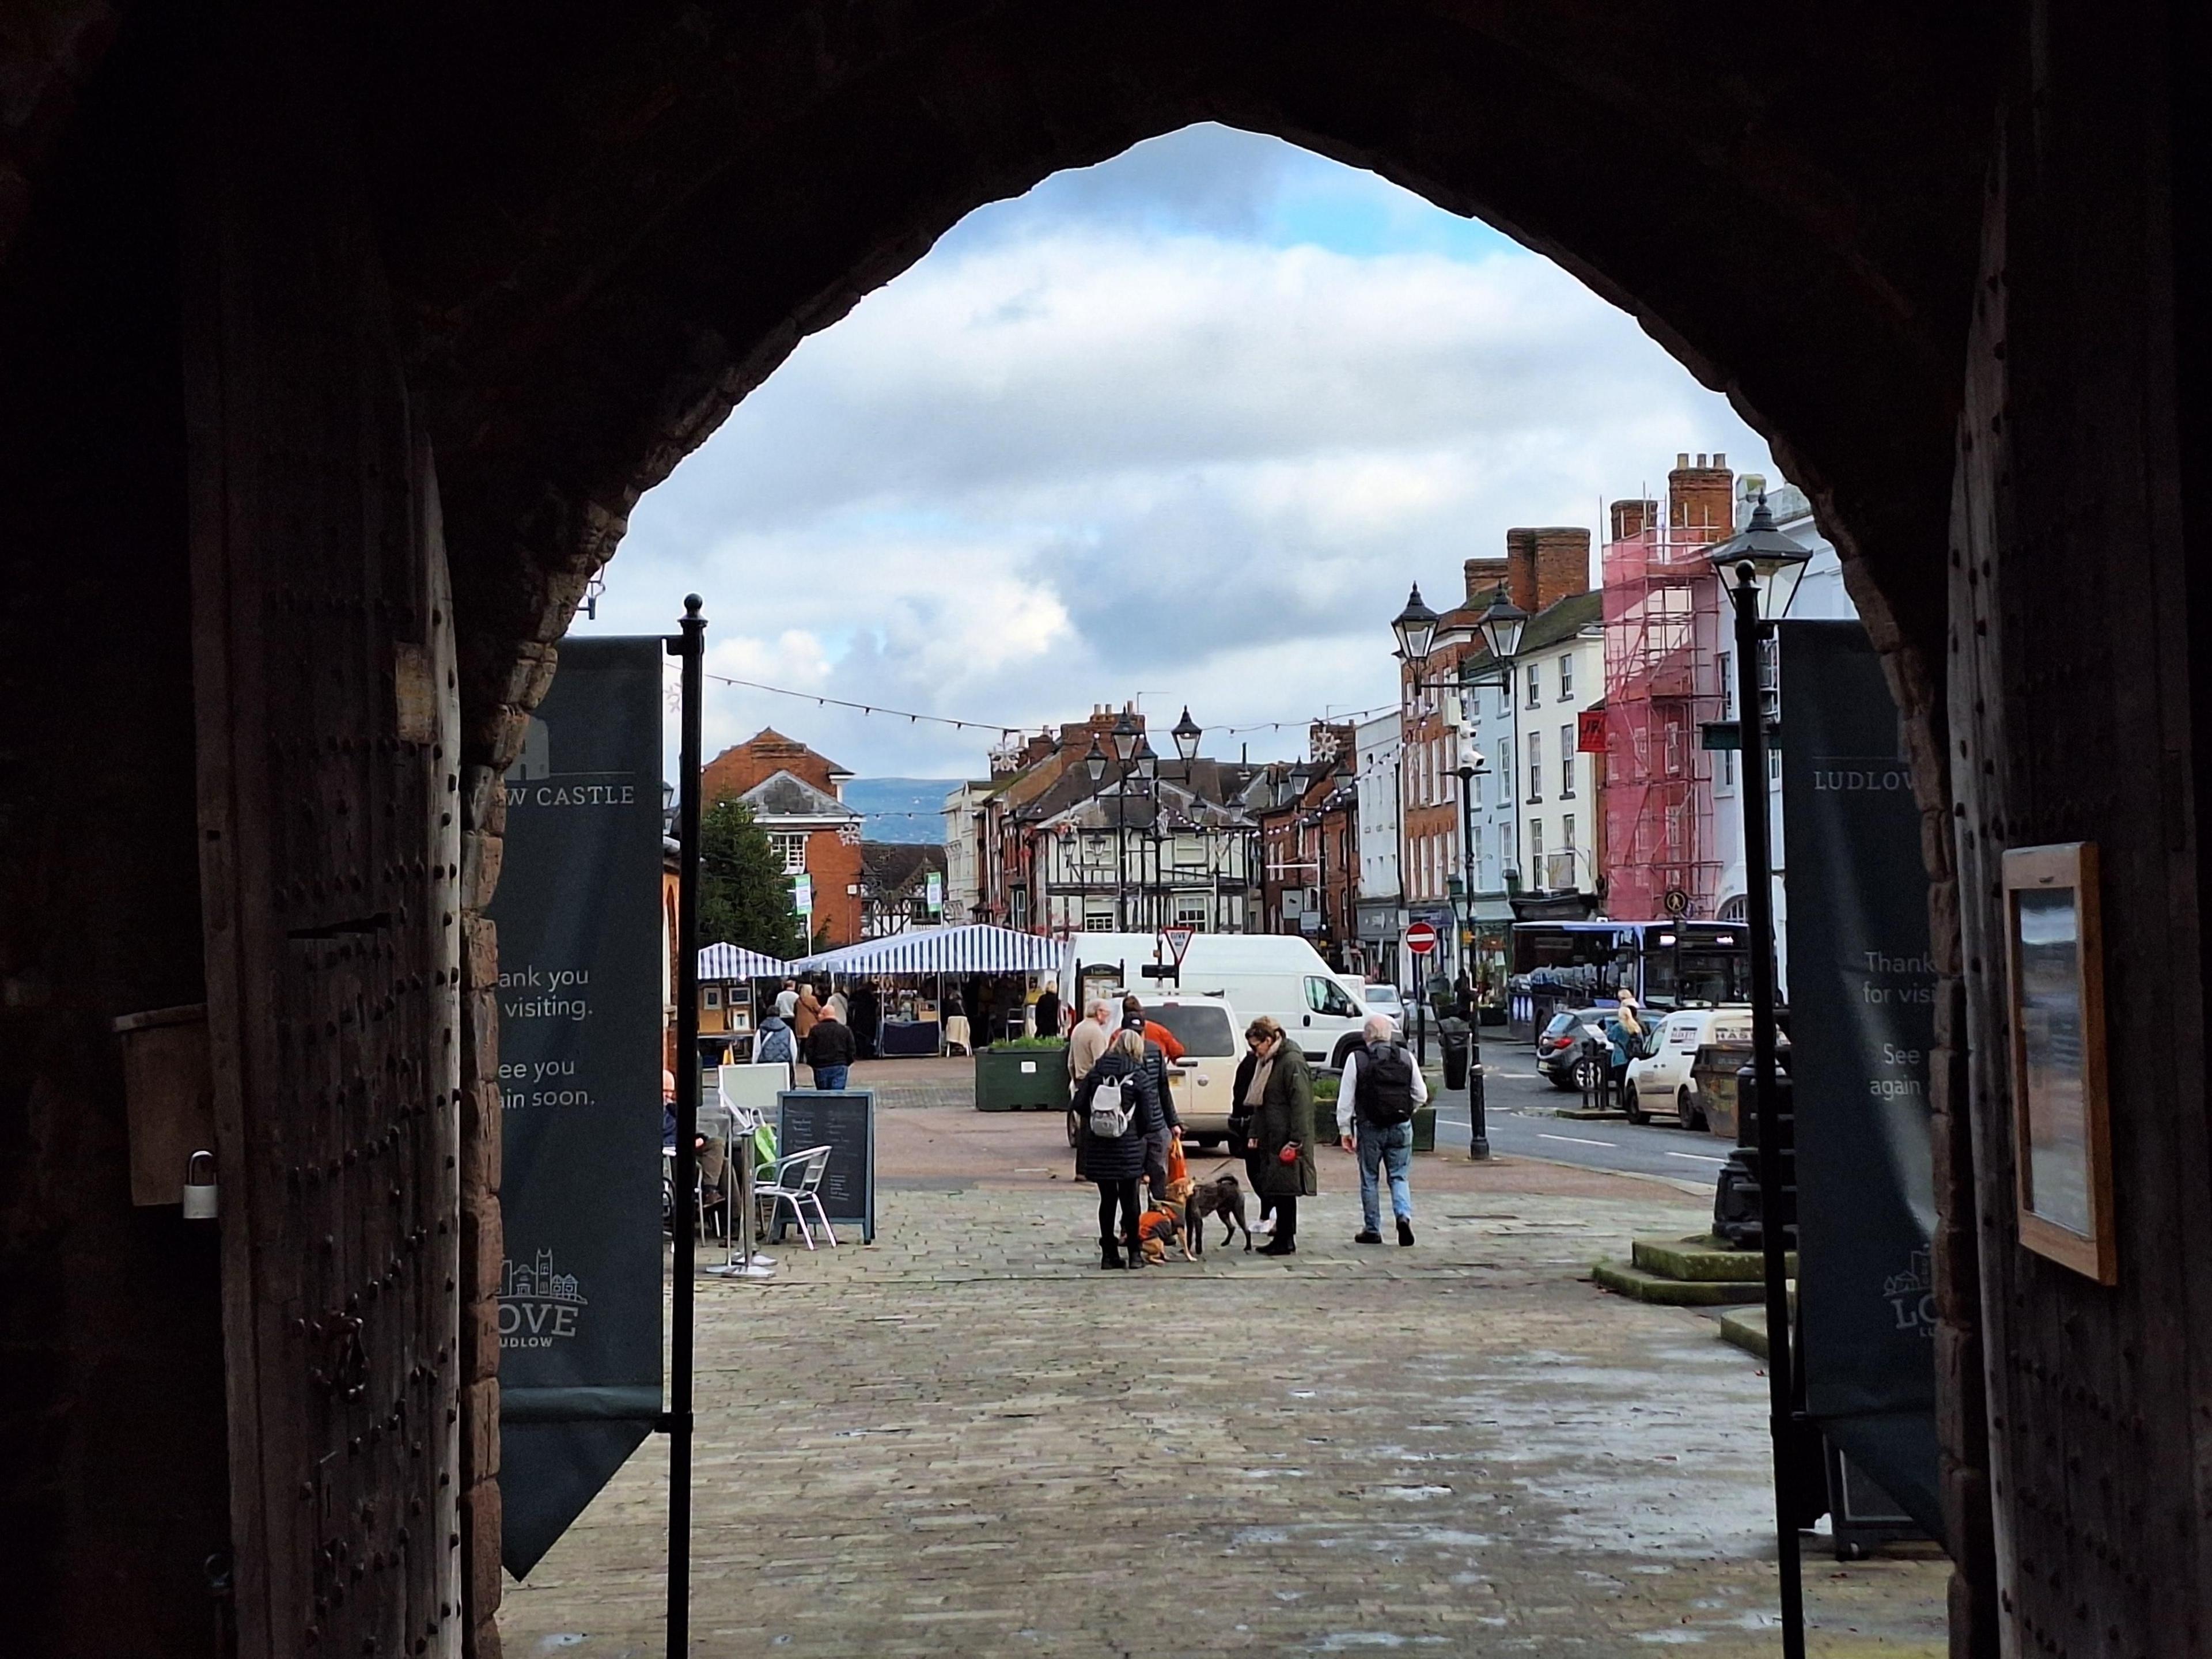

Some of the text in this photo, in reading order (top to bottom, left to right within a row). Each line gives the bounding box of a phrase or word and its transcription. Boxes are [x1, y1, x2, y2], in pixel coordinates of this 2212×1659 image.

[507, 786, 634, 807] W CASTLE
[1864, 951, 1935, 973] Thank
[499, 965, 589, 992] ank you
[1863, 980, 1891, 1003] for
[505, 994, 593, 1021] visiting.
[1884, 1043, 1919, 1065] See
[498, 1060, 574, 1083] ee you
[532, 1090, 595, 1107] soon.
[1870, 1075, 1921, 1101] again
[498, 1303, 578, 1337] OVE
[499, 1337, 552, 1347] UDLOW
